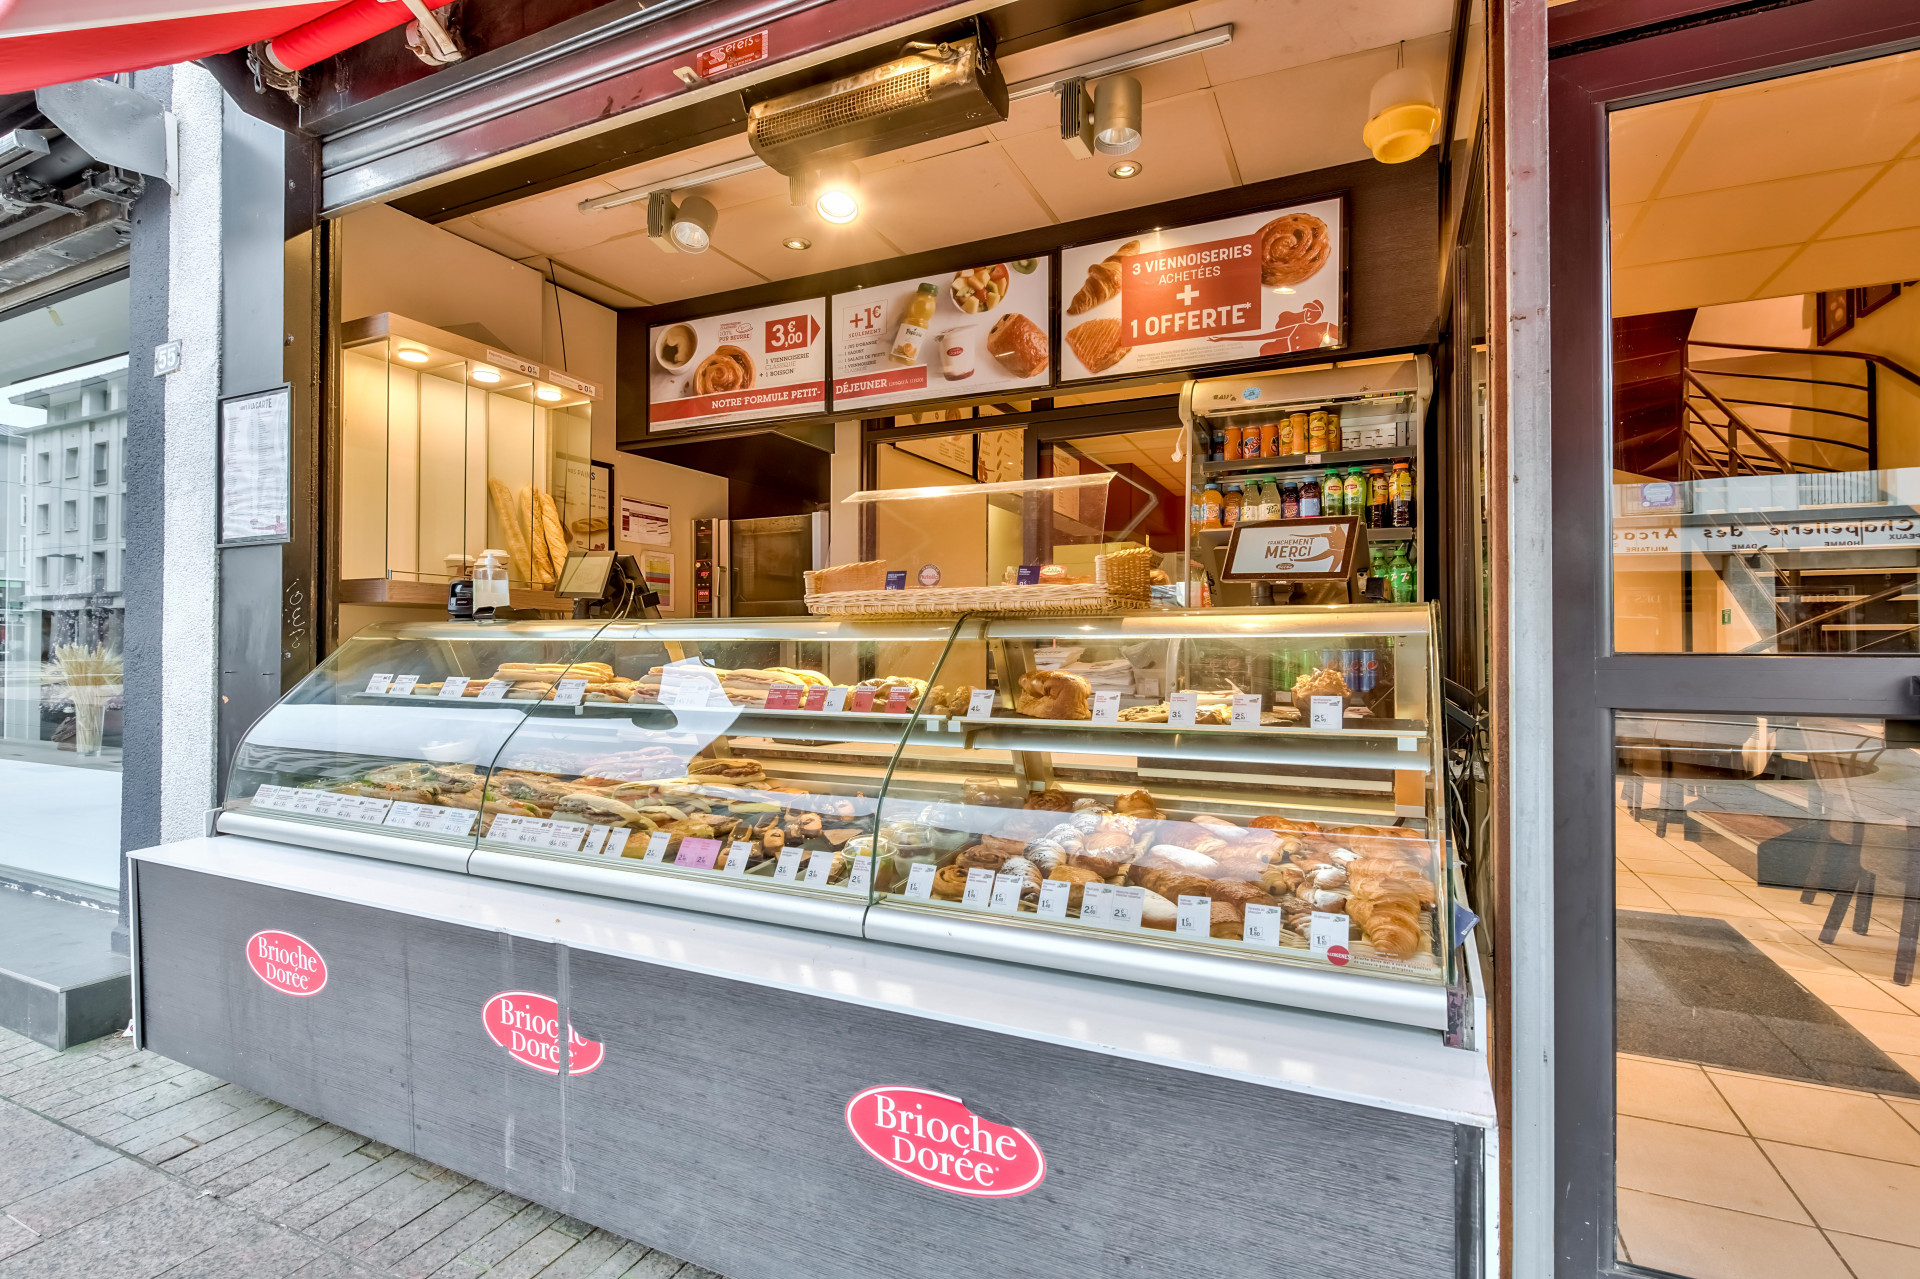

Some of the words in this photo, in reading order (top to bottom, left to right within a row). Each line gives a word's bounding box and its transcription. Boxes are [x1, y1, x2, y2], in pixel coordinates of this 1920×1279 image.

[1132, 263, 1141, 275] 3
[1145, 244, 1253, 273] VIENNOISERIES
[1158, 265, 1221, 285] ACHETÉES
[848, 328, 881, 338] SEULEMENT
[1130, 319, 1138, 338] 1
[158, 347, 176, 369] 55
[765, 361, 796, 371] CLASSIQUE
[769, 353, 810, 364] VIENNOISERIE
[770, 369, 794, 377] BOISSON
[835, 379, 888, 395] DÉJEUNER
[255, 398, 272, 409] CARTE
[712, 398, 742, 409] NOTRE
[744, 391, 789, 405] FORMULE
[791, 388, 821, 399] PETIT-
[1264, 546, 1312, 559] MERCI
[258, 936, 318, 972] Brioche
[265, 962, 309, 990] Dorée
[874, 1094, 1017, 1161] Brioche
[892, 1135, 994, 1187] Dorée
